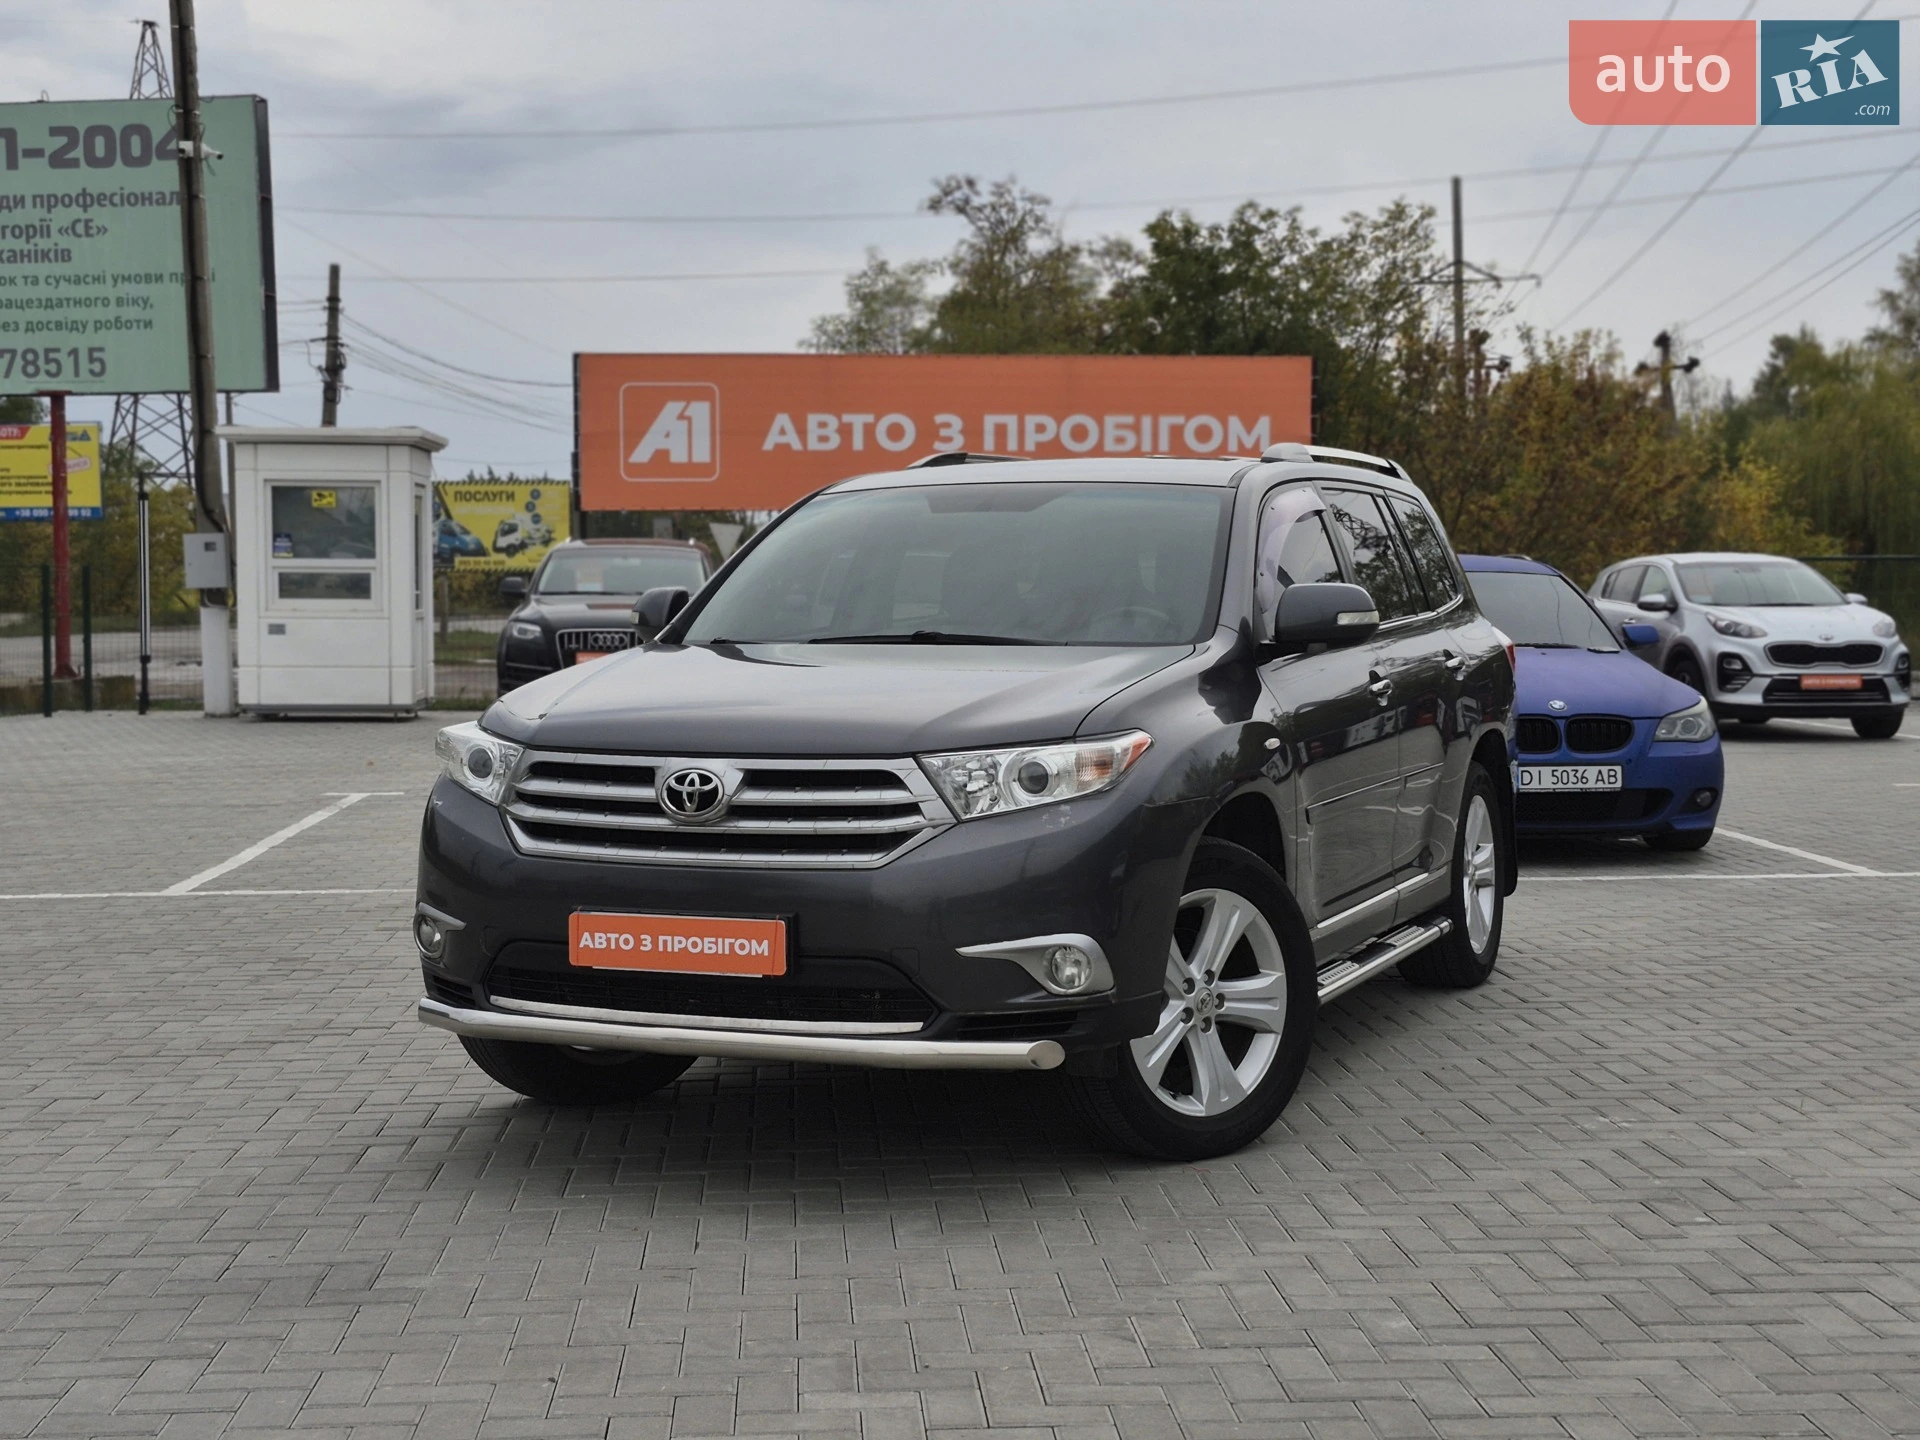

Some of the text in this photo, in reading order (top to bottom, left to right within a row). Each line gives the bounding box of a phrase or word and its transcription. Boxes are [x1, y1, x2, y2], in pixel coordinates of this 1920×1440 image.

[22, 275, 40, 287] та
[44, 270, 106, 289] сучасні
[111, 272, 164, 288] умови
[0, 296, 111, 311] ацездатного
[0, 316, 153, 334] ез досвіду роботи
[0, 347, 107, 379] 78515
[762, 412, 1271, 454] АВТО З ПРОБІГОМ
[454, 490, 515, 502] ПОСЛУГИ
[1520, 768, 1618, 786] DI 5036 AB
[579, 932, 769, 956] АВТО З ПРОБІГОМ
